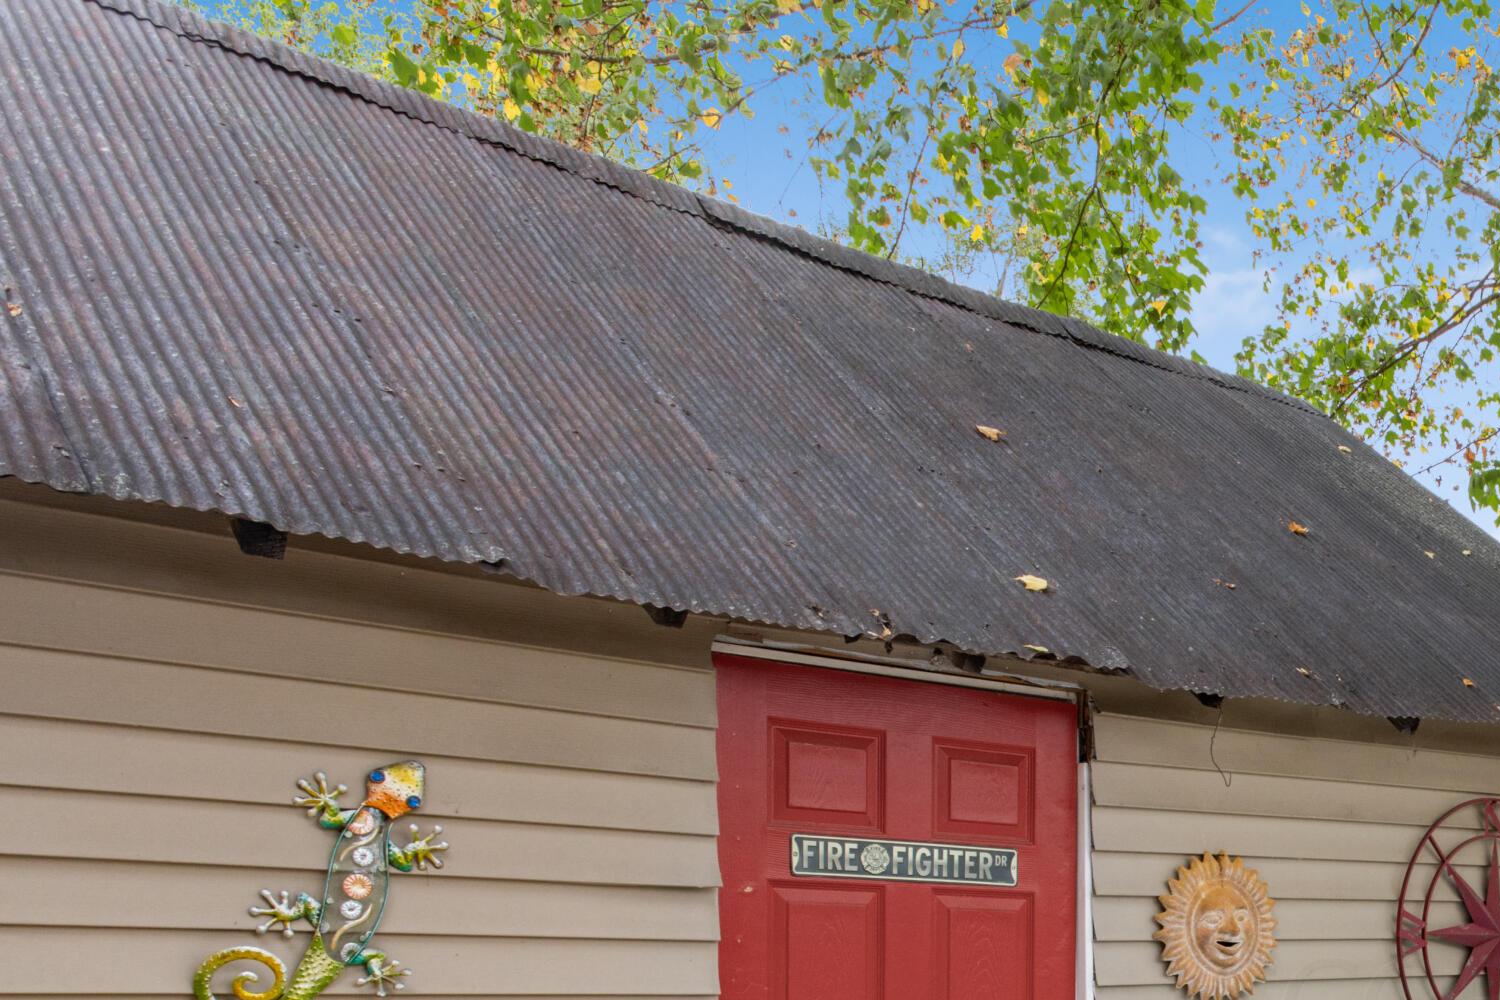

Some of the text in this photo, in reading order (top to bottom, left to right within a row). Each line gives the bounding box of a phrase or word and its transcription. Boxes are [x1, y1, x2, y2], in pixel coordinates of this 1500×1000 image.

[802, 840, 1008, 880] FIRE FIGHTER DR
